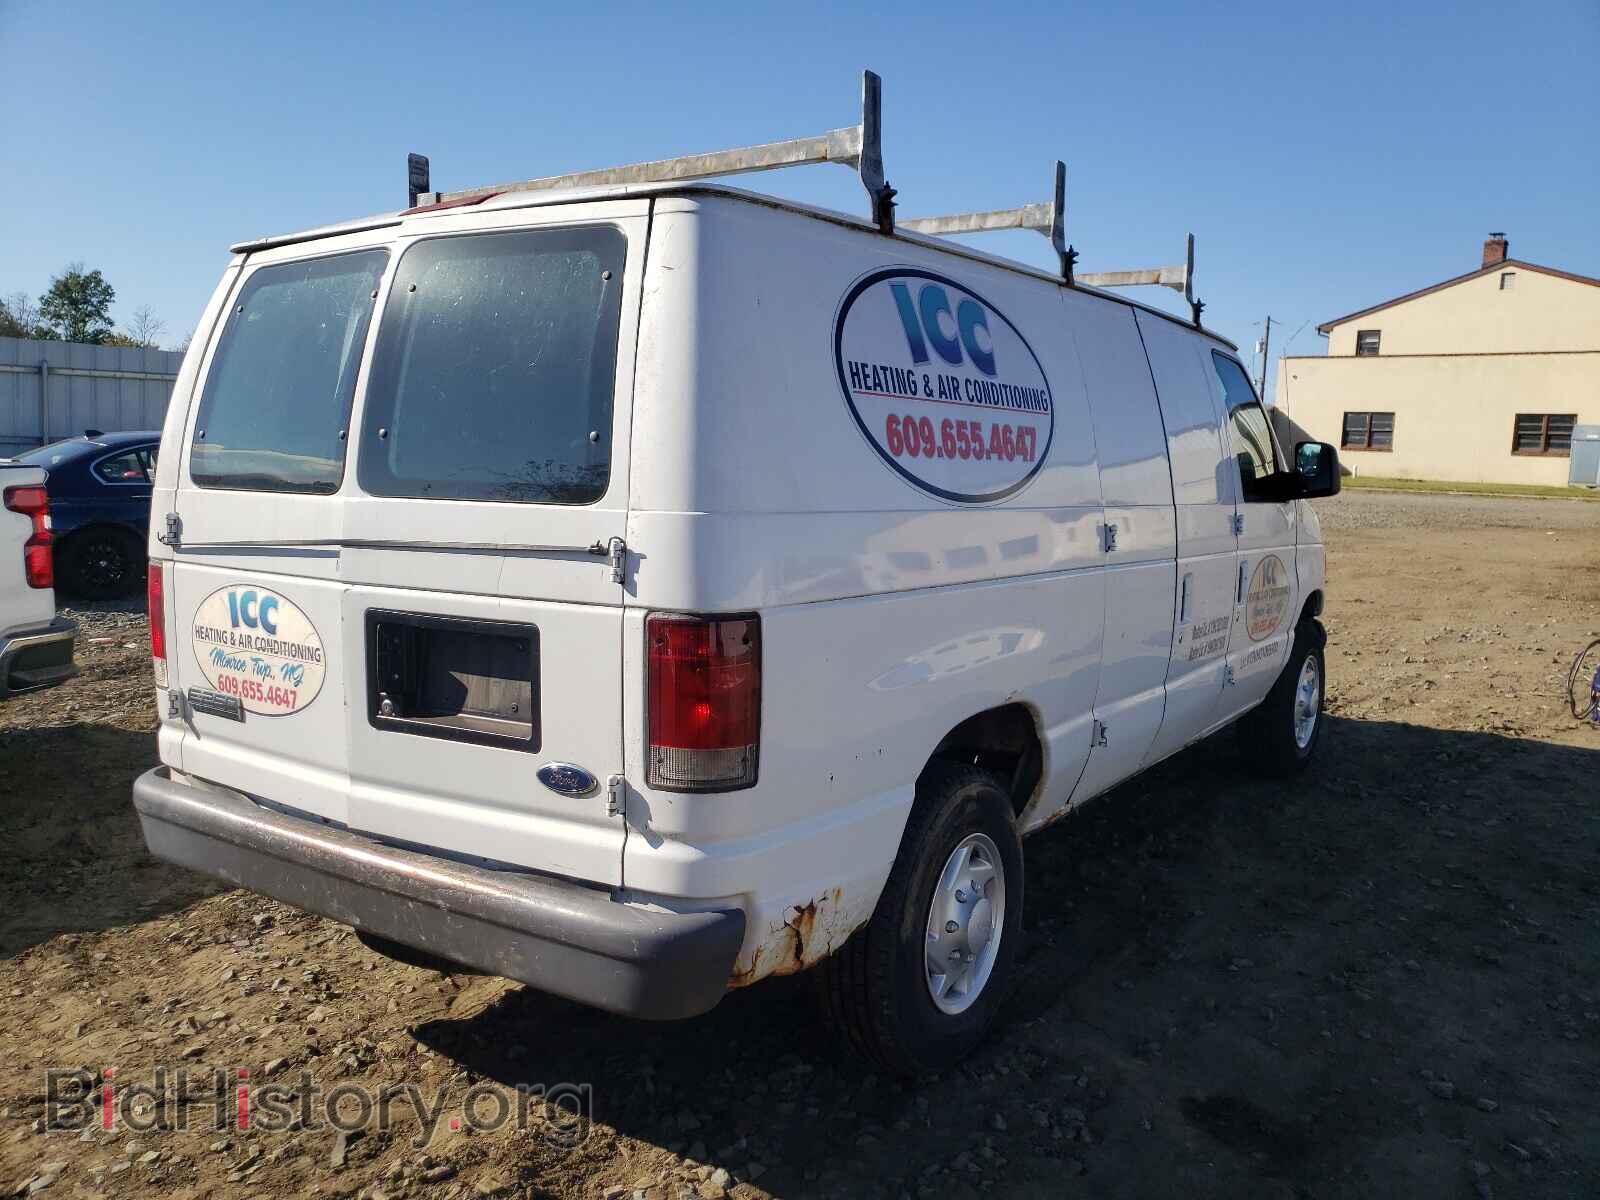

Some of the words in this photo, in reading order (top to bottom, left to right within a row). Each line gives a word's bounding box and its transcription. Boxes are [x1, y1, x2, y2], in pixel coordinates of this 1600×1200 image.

[888, 280, 997, 377] ICC
[848, 361, 918, 396] HEATING
[923, 374, 934, 398] &
[938, 374, 960, 401] AIR
[964, 378, 1049, 412] CONDITIONING
[885, 413, 1036, 462] 609.655.4647
[227, 590, 279, 635] ICC
[194, 624, 228, 645] HEATING
[230, 633, 236, 646] &
[238, 633, 253, 649] AIR
[254, 636, 321, 663] CONDITIONING
[209, 646, 247, 673] Monroe
[217, 674, 297, 710] 609.655.4647
